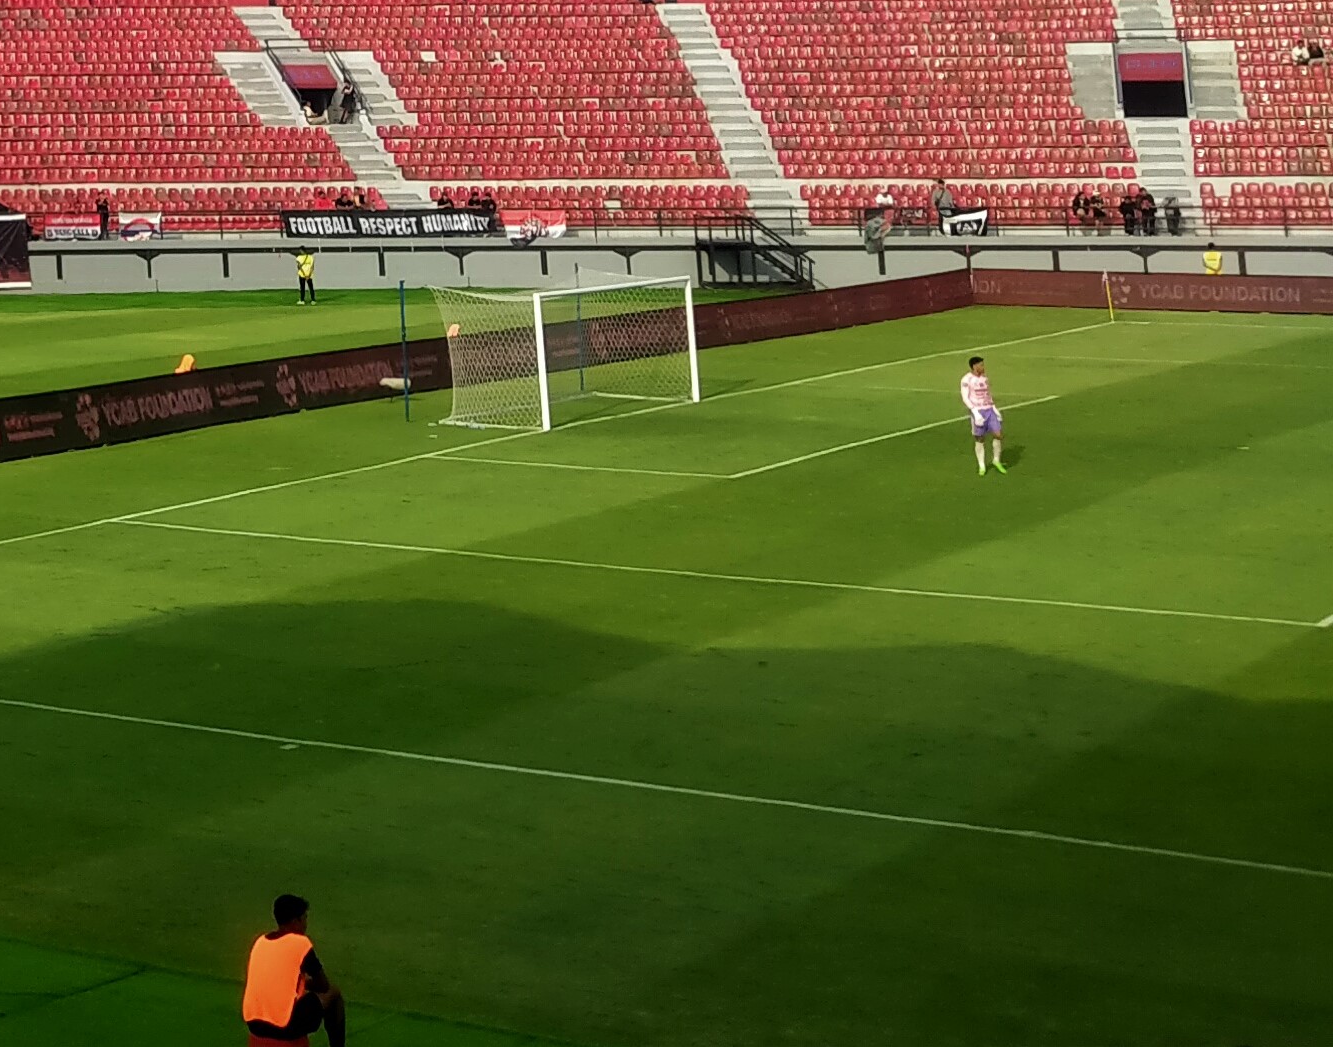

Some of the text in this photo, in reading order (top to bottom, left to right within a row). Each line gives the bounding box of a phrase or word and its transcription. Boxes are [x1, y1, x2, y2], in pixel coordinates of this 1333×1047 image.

[288, 213, 491, 236] FOOTBALL RESPECT HUMANITY
[1140, 283, 1184, 300] YCAB
[1189, 283, 1301, 303] FOUNDATION
